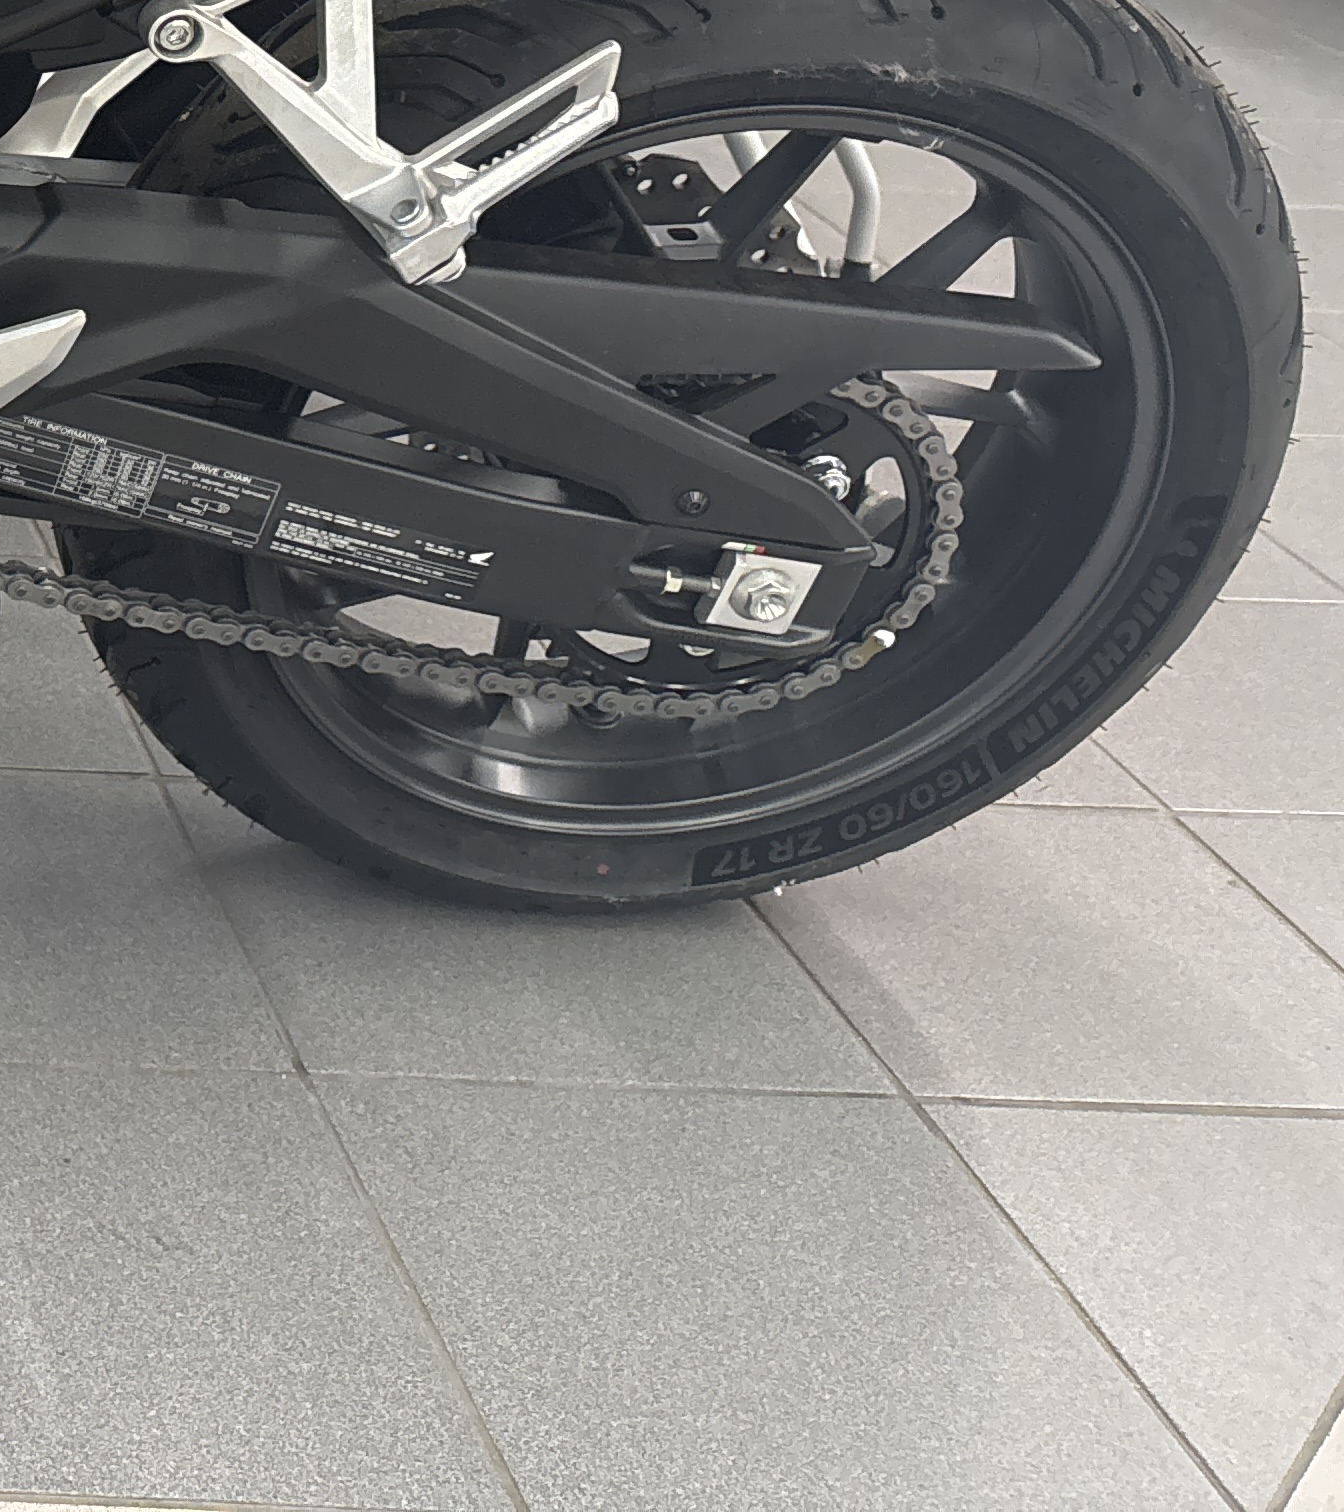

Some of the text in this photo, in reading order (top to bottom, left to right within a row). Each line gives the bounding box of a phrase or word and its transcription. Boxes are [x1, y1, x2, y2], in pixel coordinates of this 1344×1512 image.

[21, 414, 108, 446] TIRE INFORMATION
[191, 462, 252, 485] DRIVE CHAIN
[1006, 564, 1181, 754] MICHELIN
[711, 758, 982, 877] 160/60 ZR 17
